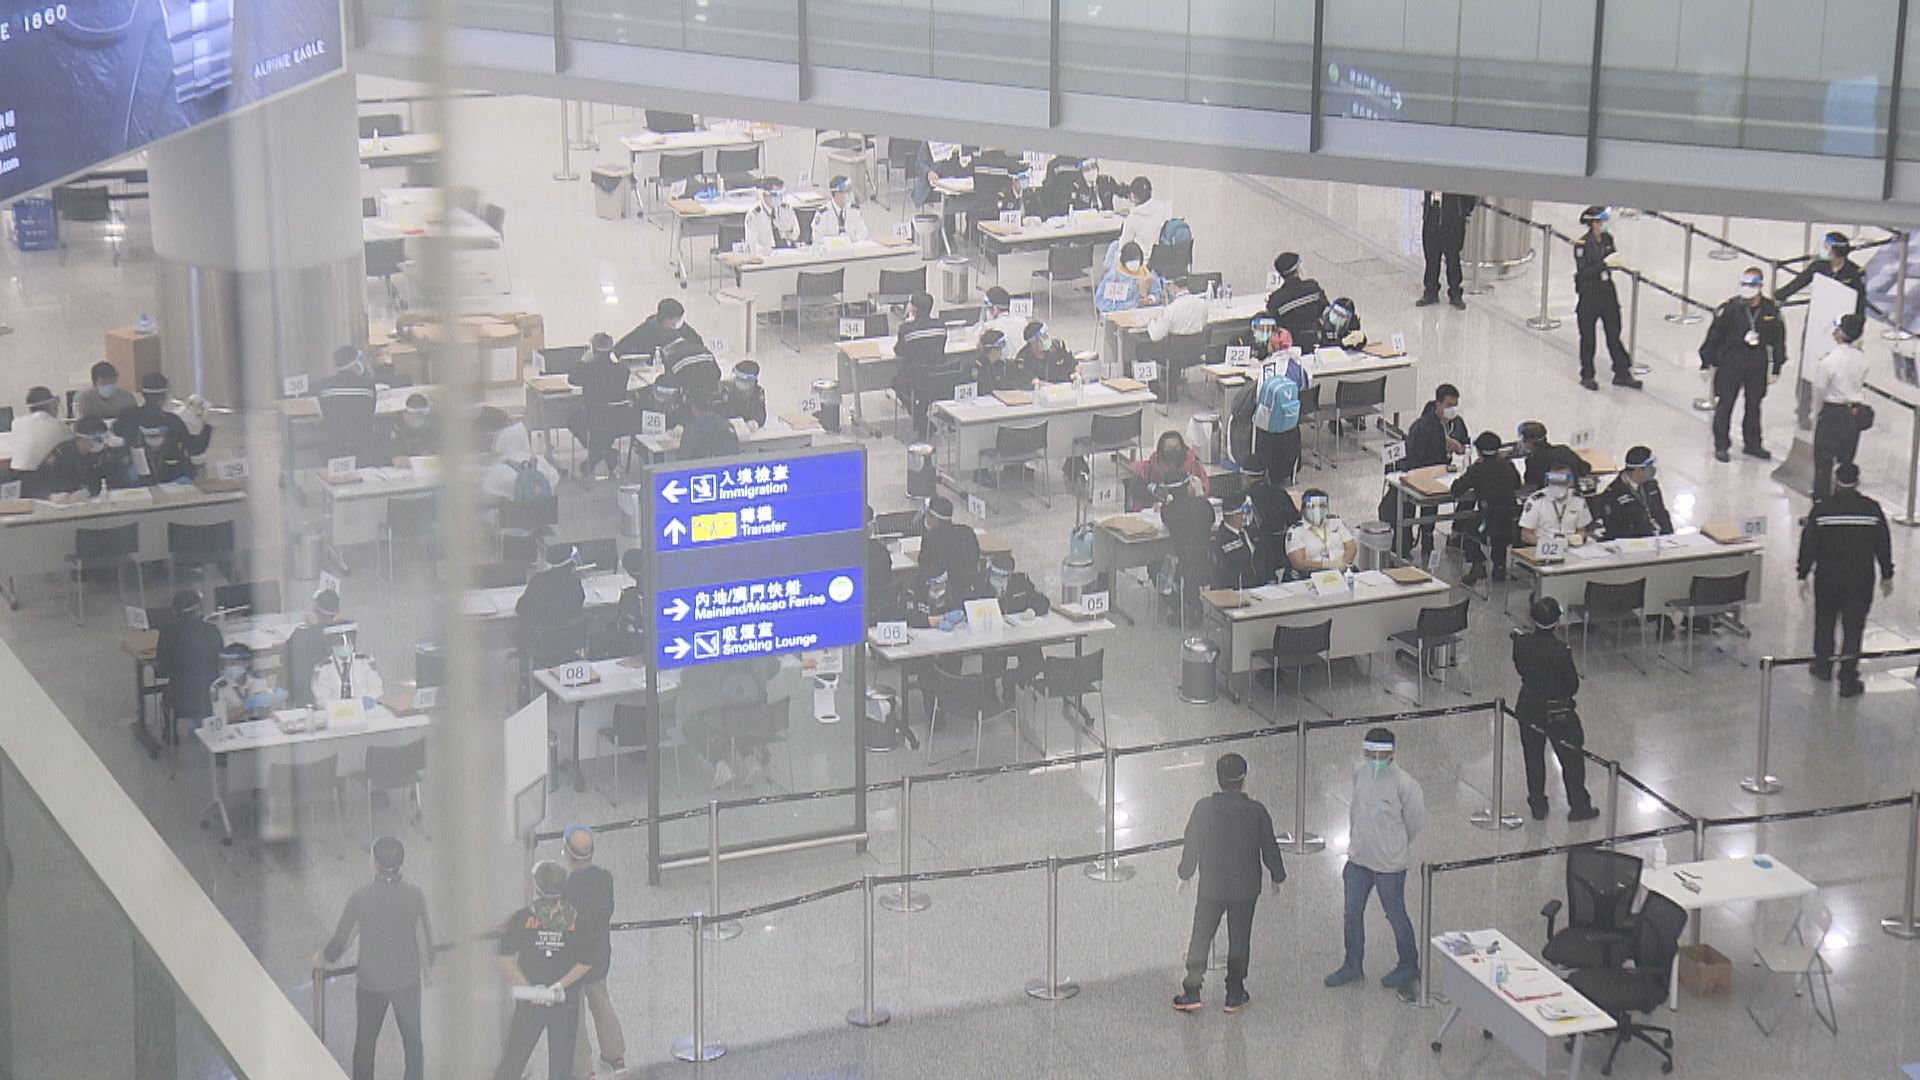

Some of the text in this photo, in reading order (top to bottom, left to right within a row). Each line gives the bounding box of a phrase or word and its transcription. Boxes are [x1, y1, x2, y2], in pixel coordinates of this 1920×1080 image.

[24, 4, 67, 32] 1860
[293, 39, 325, 64] EAGLE
[720, 464, 789, 487] 入境檢查
[720, 482, 788, 499] Immigration
[741, 520, 787, 537] Transfer
[1541, 543, 1559, 555] 02
[694, 594, 825, 620] Mainland/Macao Ferries
[1087, 598, 1103, 611] 05
[882, 626, 901, 639] 06
[723, 634, 817, 655] Smoking Lounge
[566, 666, 583, 679] 08
